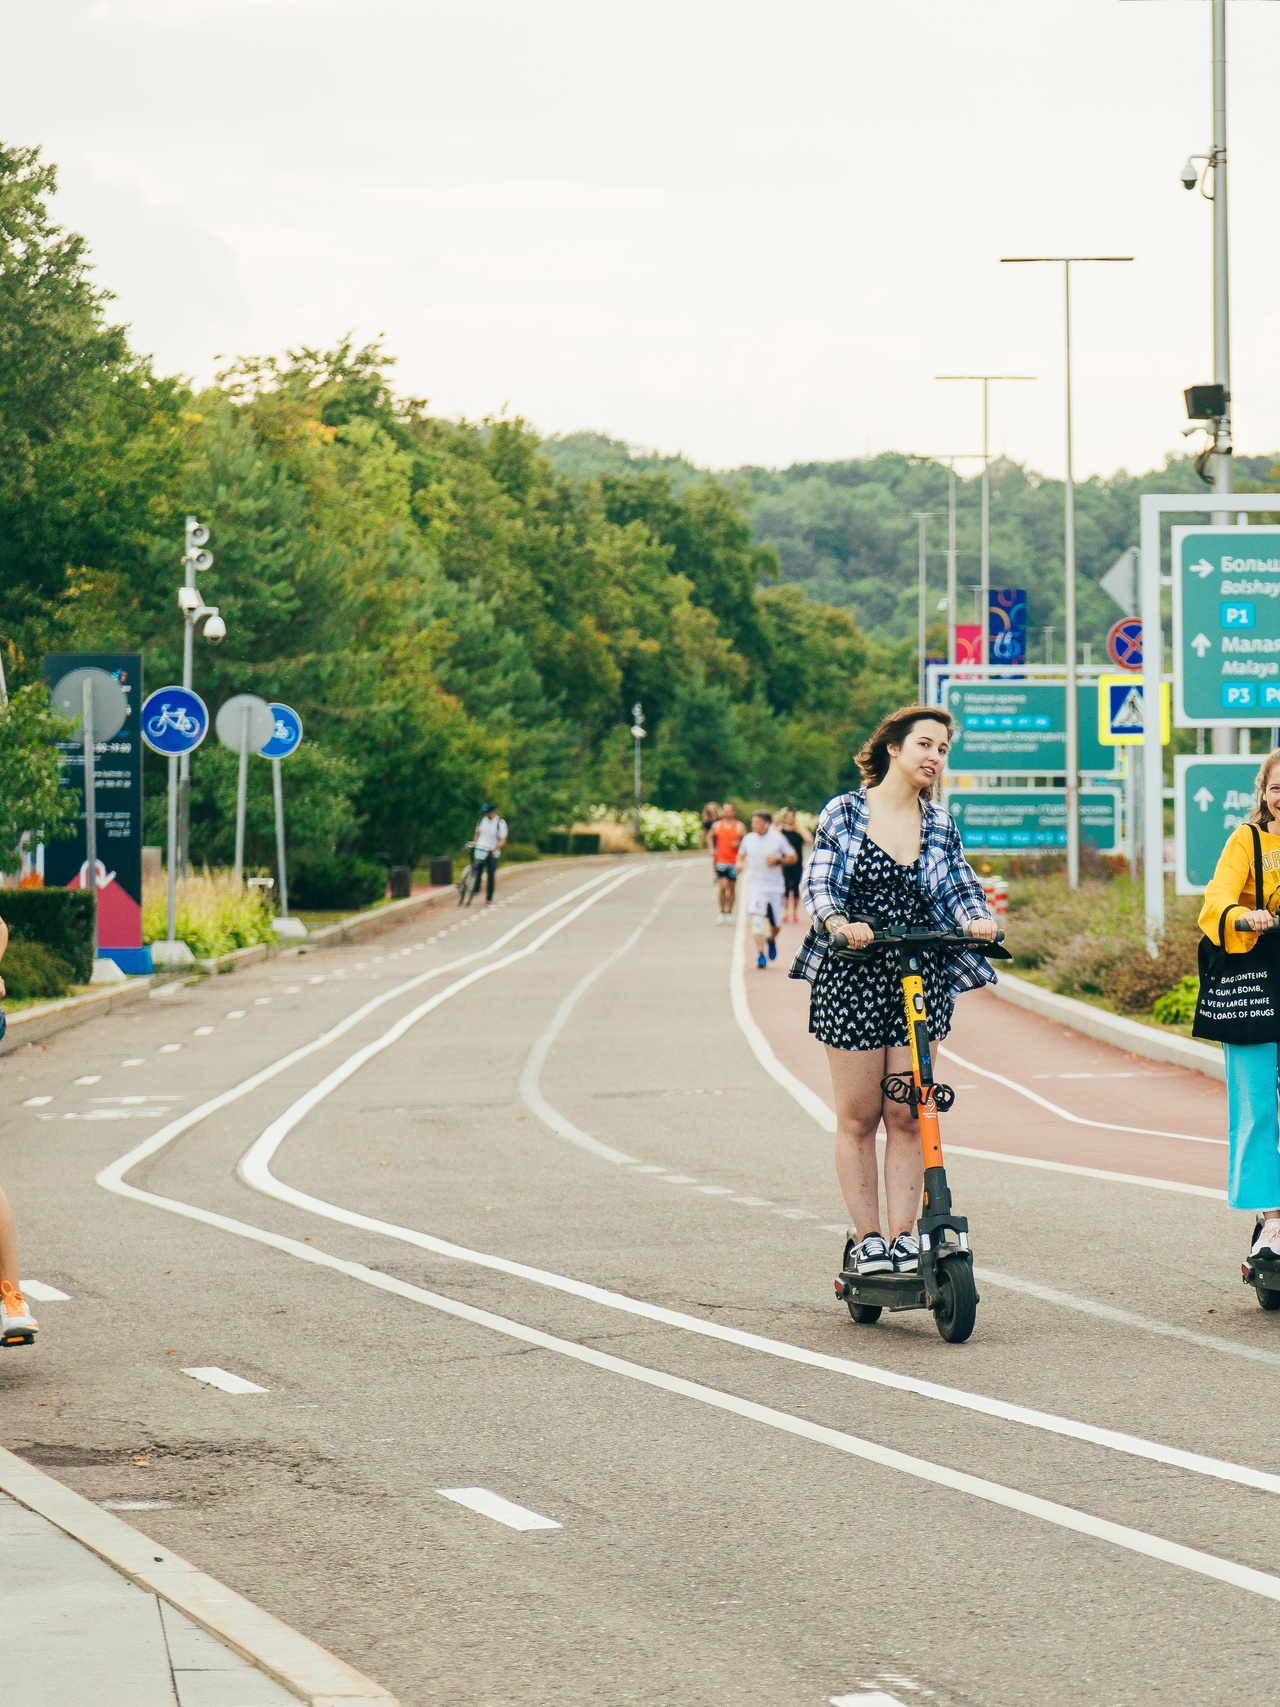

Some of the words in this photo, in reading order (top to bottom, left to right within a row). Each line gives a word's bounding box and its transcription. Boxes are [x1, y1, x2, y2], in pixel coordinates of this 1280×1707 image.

[1227, 608, 1248, 623] P1
[1221, 660, 1279, 678] Malaya
[1229, 688, 1249, 703] P3
[1208, 1000, 1225, 1008] VERY
[1227, 999, 1247, 1007] LARGE
[1250, 997, 1269, 1005] KNIFE
[1200, 1010, 1211, 1018] AND
[1250, 1009, 1274, 1017] DRUGS
